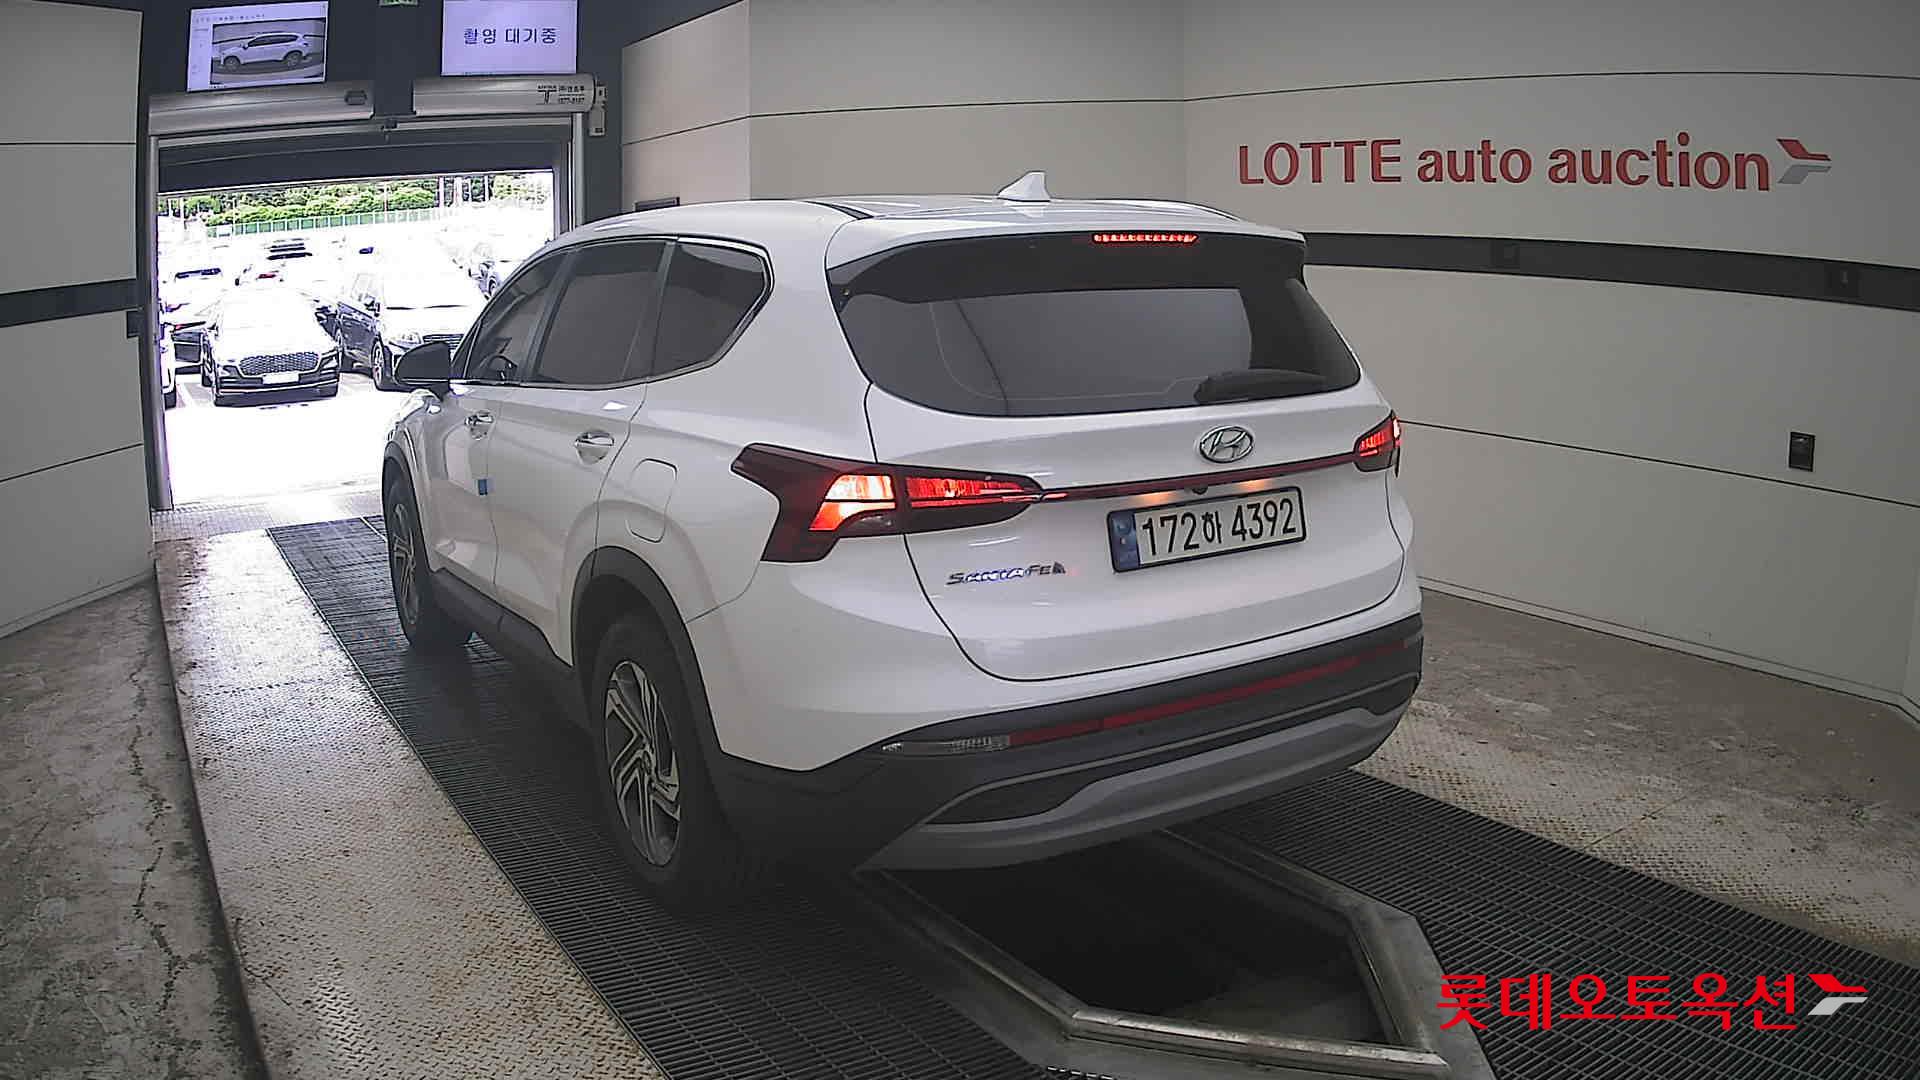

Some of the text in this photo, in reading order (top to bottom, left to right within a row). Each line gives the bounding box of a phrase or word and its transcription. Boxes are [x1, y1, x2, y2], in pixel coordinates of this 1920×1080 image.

[505, 28, 557, 44] 대기중
[1239, 131, 1770, 191] LOTTE auto auction
[1142, 498, 1297, 556] 172하 4392
